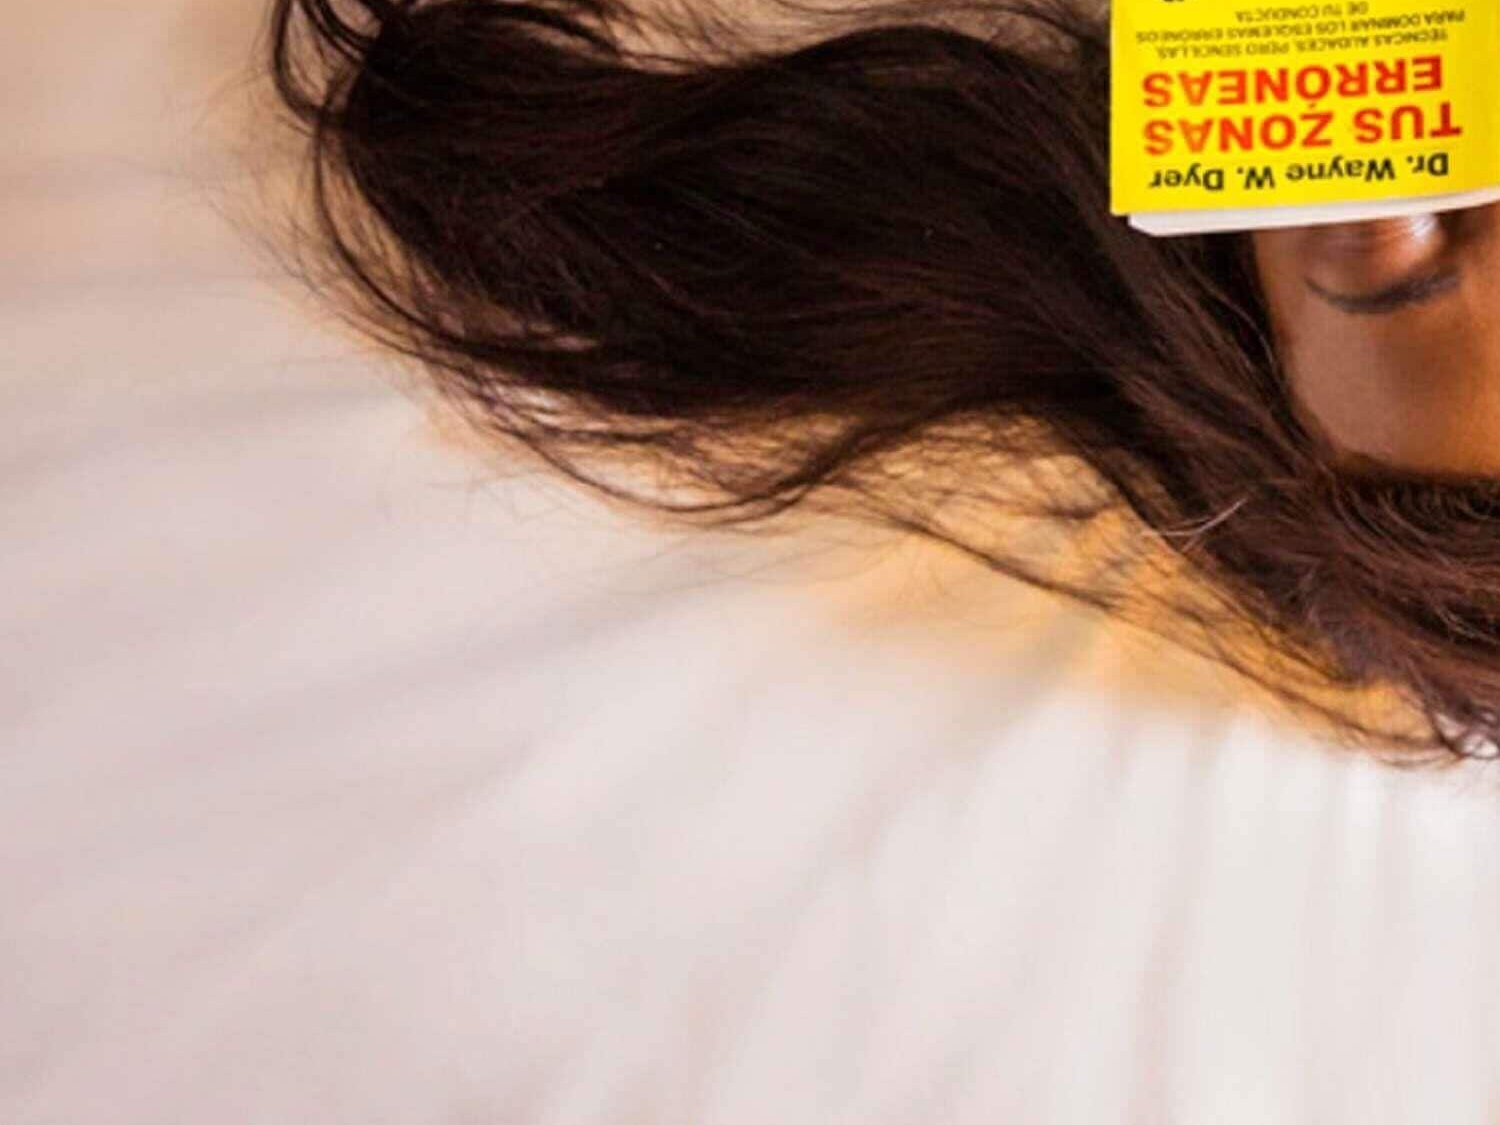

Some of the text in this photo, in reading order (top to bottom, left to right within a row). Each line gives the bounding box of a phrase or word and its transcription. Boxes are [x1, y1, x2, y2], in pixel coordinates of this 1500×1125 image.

[1235, 0, 1369, 22] DE TU CONDUCTA
[1423, 9, 1465, 24] PARA
[1315, 19, 1345, 34] LOS
[1350, 13, 1420, 30] DOMINAR
[1226, 23, 1312, 39] ESQUEMAS
[1245, 41, 1289, 56] PERO
[1142, 55, 1443, 110] ERRÓNEAS
[1143, 101, 1462, 156] TUS ZONAS
[1150, 152, 1449, 192] Dr. Wayne W. Dyer
